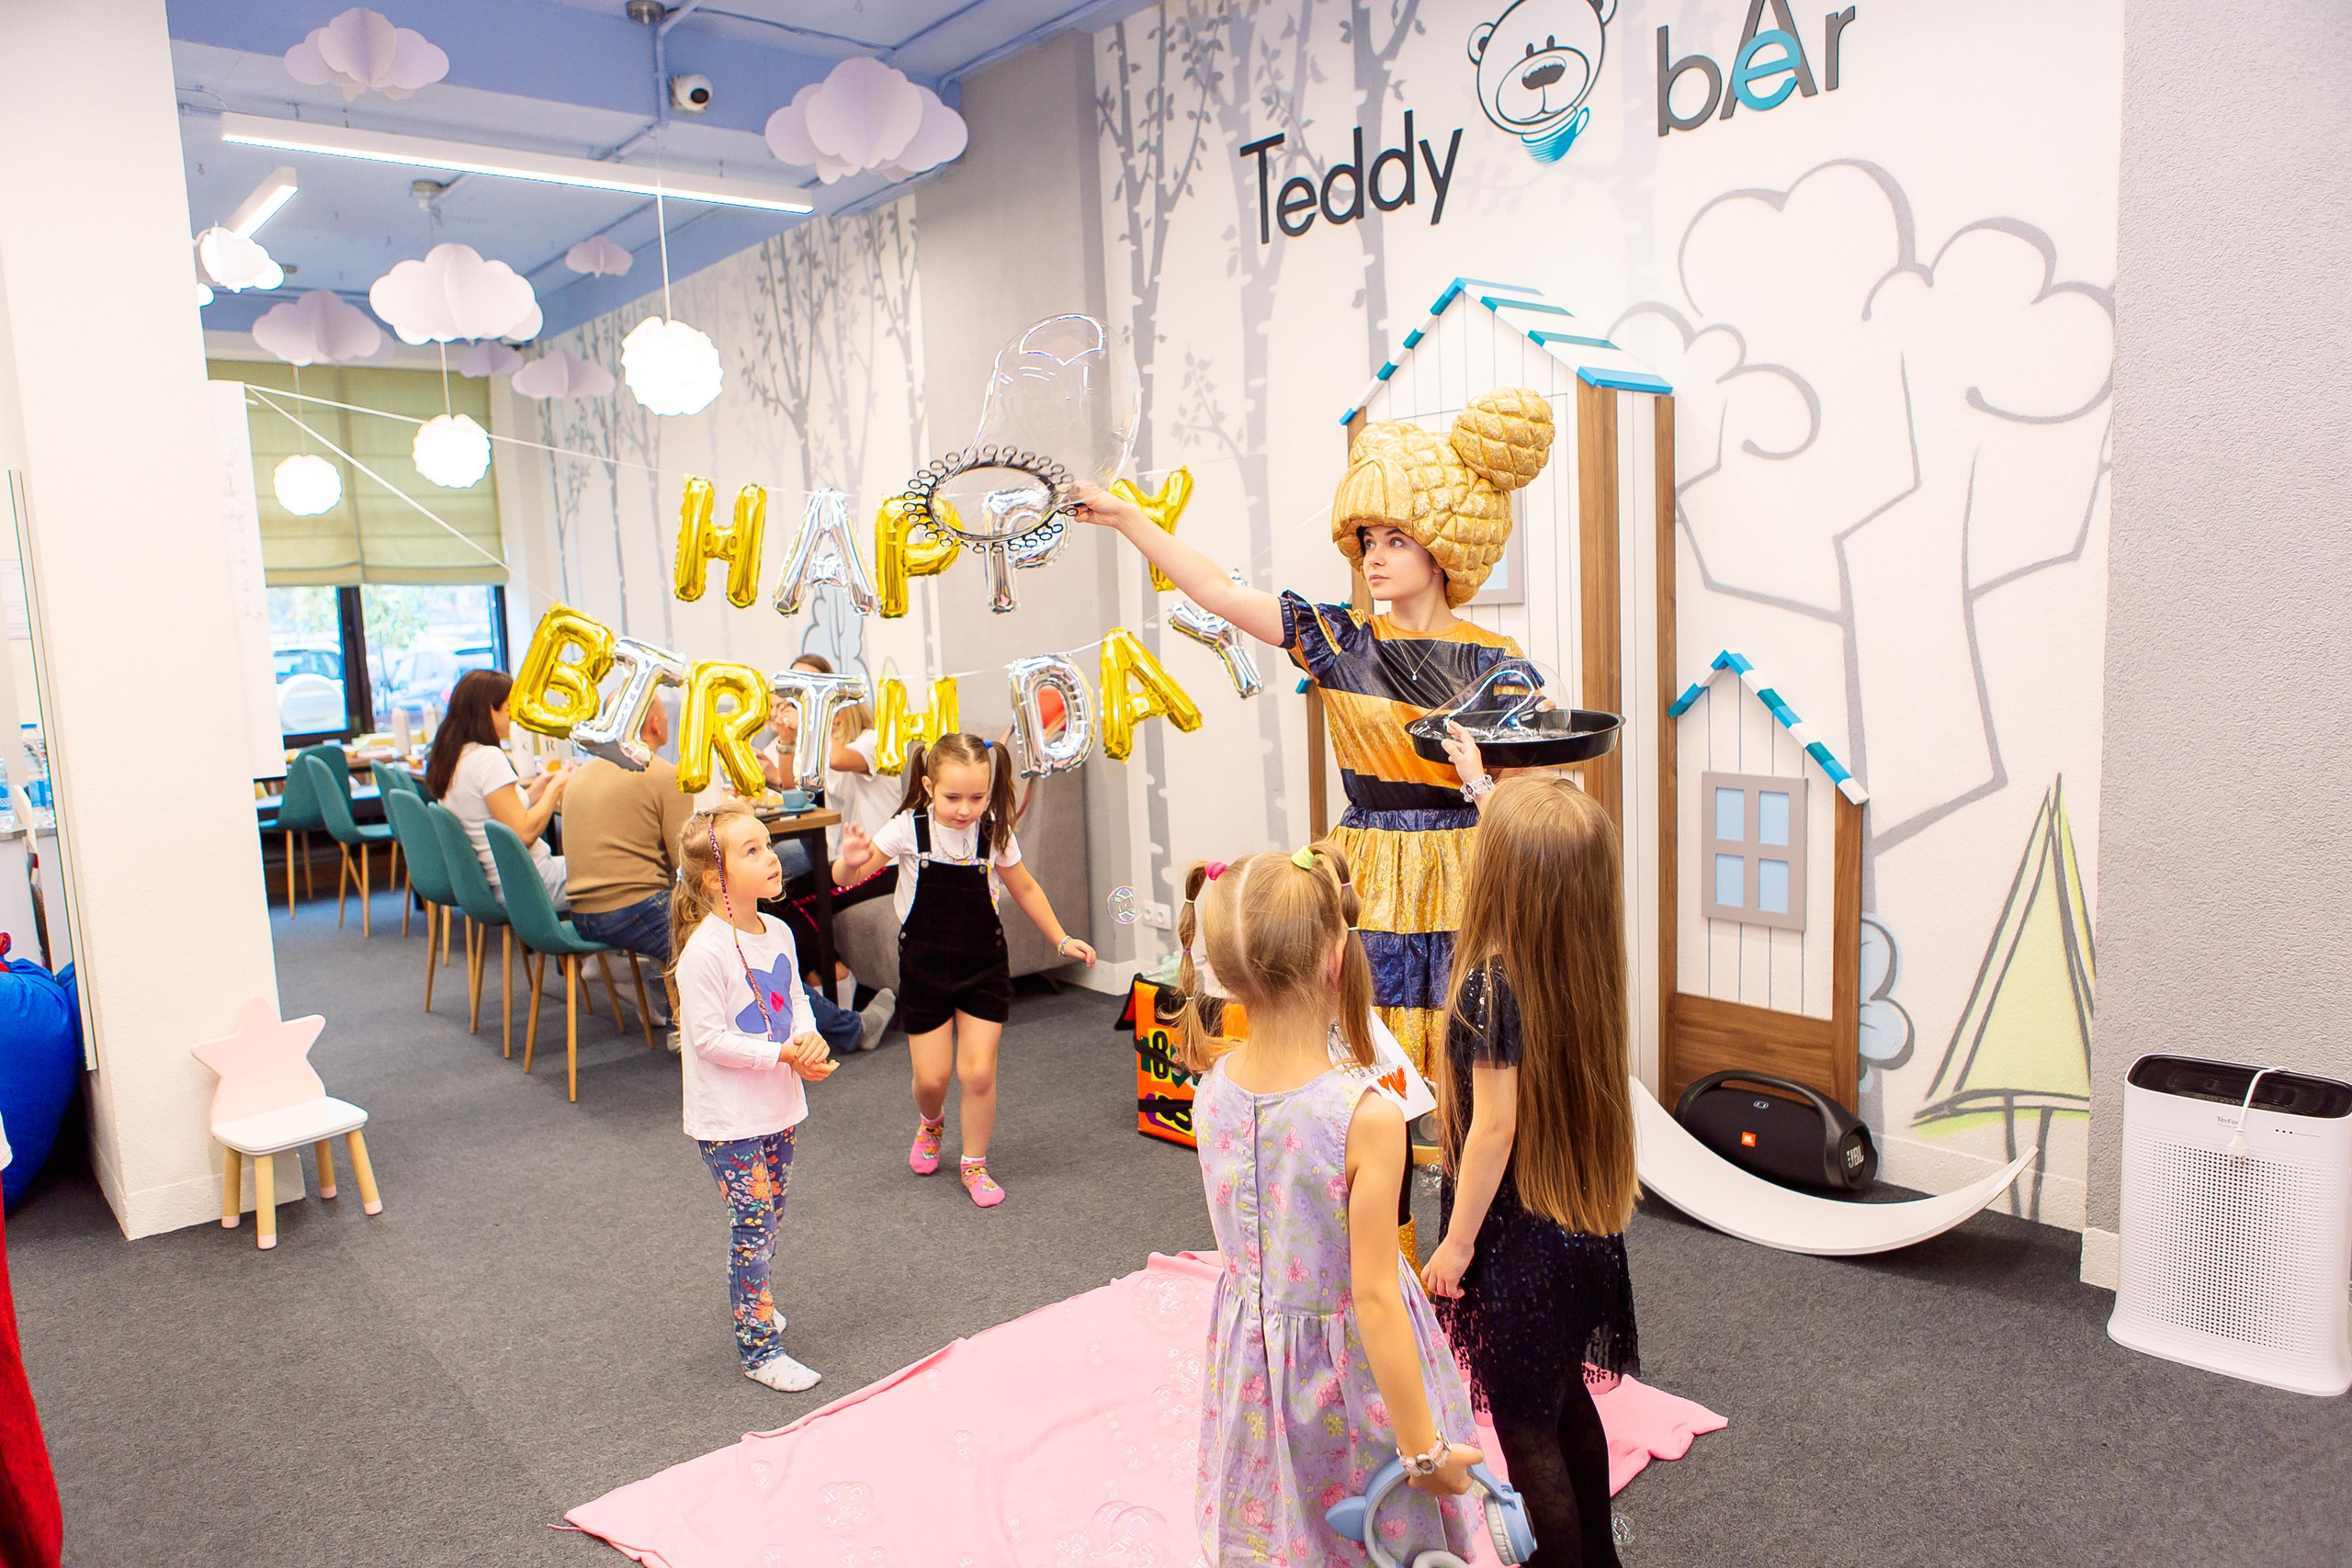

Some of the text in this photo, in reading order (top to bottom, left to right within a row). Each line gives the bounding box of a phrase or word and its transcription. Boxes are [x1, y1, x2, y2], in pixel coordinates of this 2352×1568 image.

[1239, 109, 1464, 245] Teddy
[673, 465, 1194, 618] HAPPY
[509, 568, 1264, 798] BIRTHDAY
[1847, 1145, 1864, 1168] JBL
[2215, 1115, 2239, 1125] Tefa
